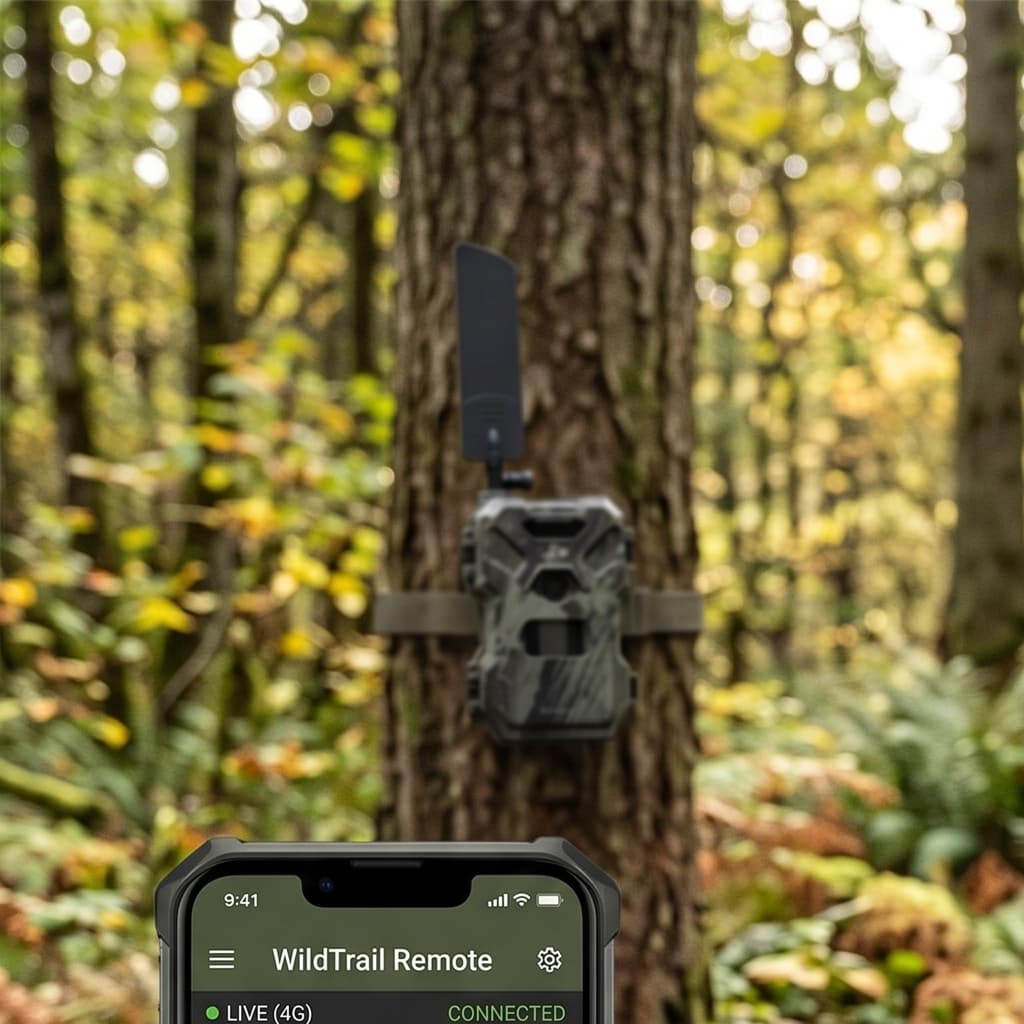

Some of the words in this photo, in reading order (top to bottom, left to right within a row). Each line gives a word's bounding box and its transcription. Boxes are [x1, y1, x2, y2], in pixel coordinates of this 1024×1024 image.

[224, 893, 258, 907] 9:41
[272, 947, 385, 971] WildTrail
[394, 948, 493, 971] Remote
[227, 1005, 268, 1022] LIVE
[448, 1004, 566, 1022] CONNECTED
